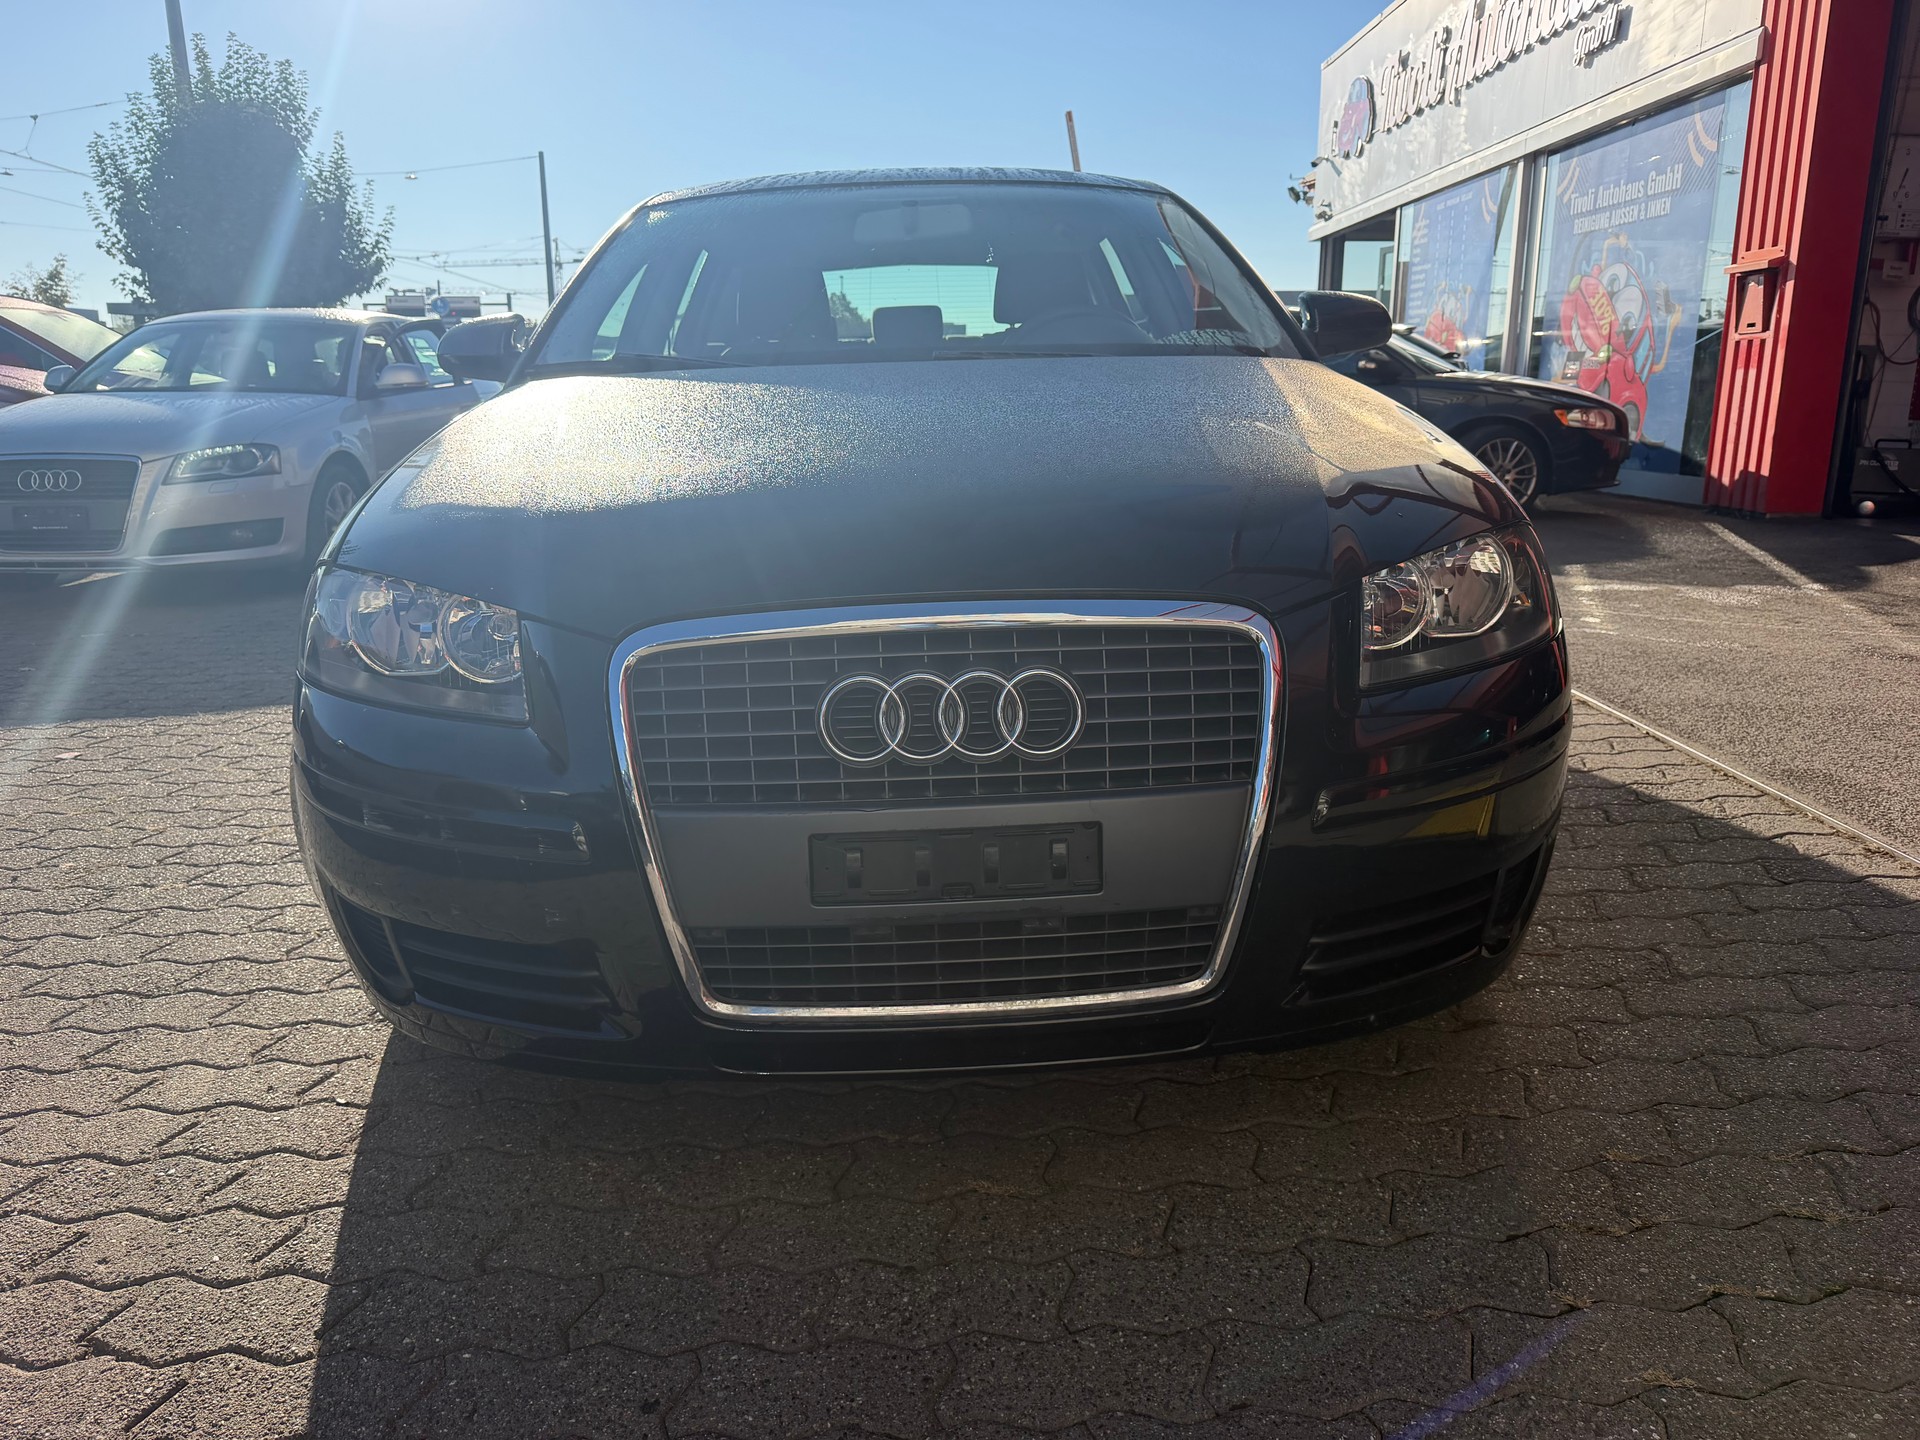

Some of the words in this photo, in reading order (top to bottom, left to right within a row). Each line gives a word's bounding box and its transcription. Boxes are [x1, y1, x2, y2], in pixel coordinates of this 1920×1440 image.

[1572, 4, 1625, 68] GmbH
[1381, 26, 1449, 133] Tivoli
[1445, 0, 1608, 105] Autoha
[1570, 188, 1595, 216] Tivoli
[1596, 180, 1644, 209] Autohaus
[1647, 163, 1683, 196] GmbH
[1573, 211, 1610, 235] REINIGUNG
[1610, 203, 1639, 227] AUSSEN
[1639, 203, 1646, 220] &
[1647, 196, 1672, 219] INNEN
